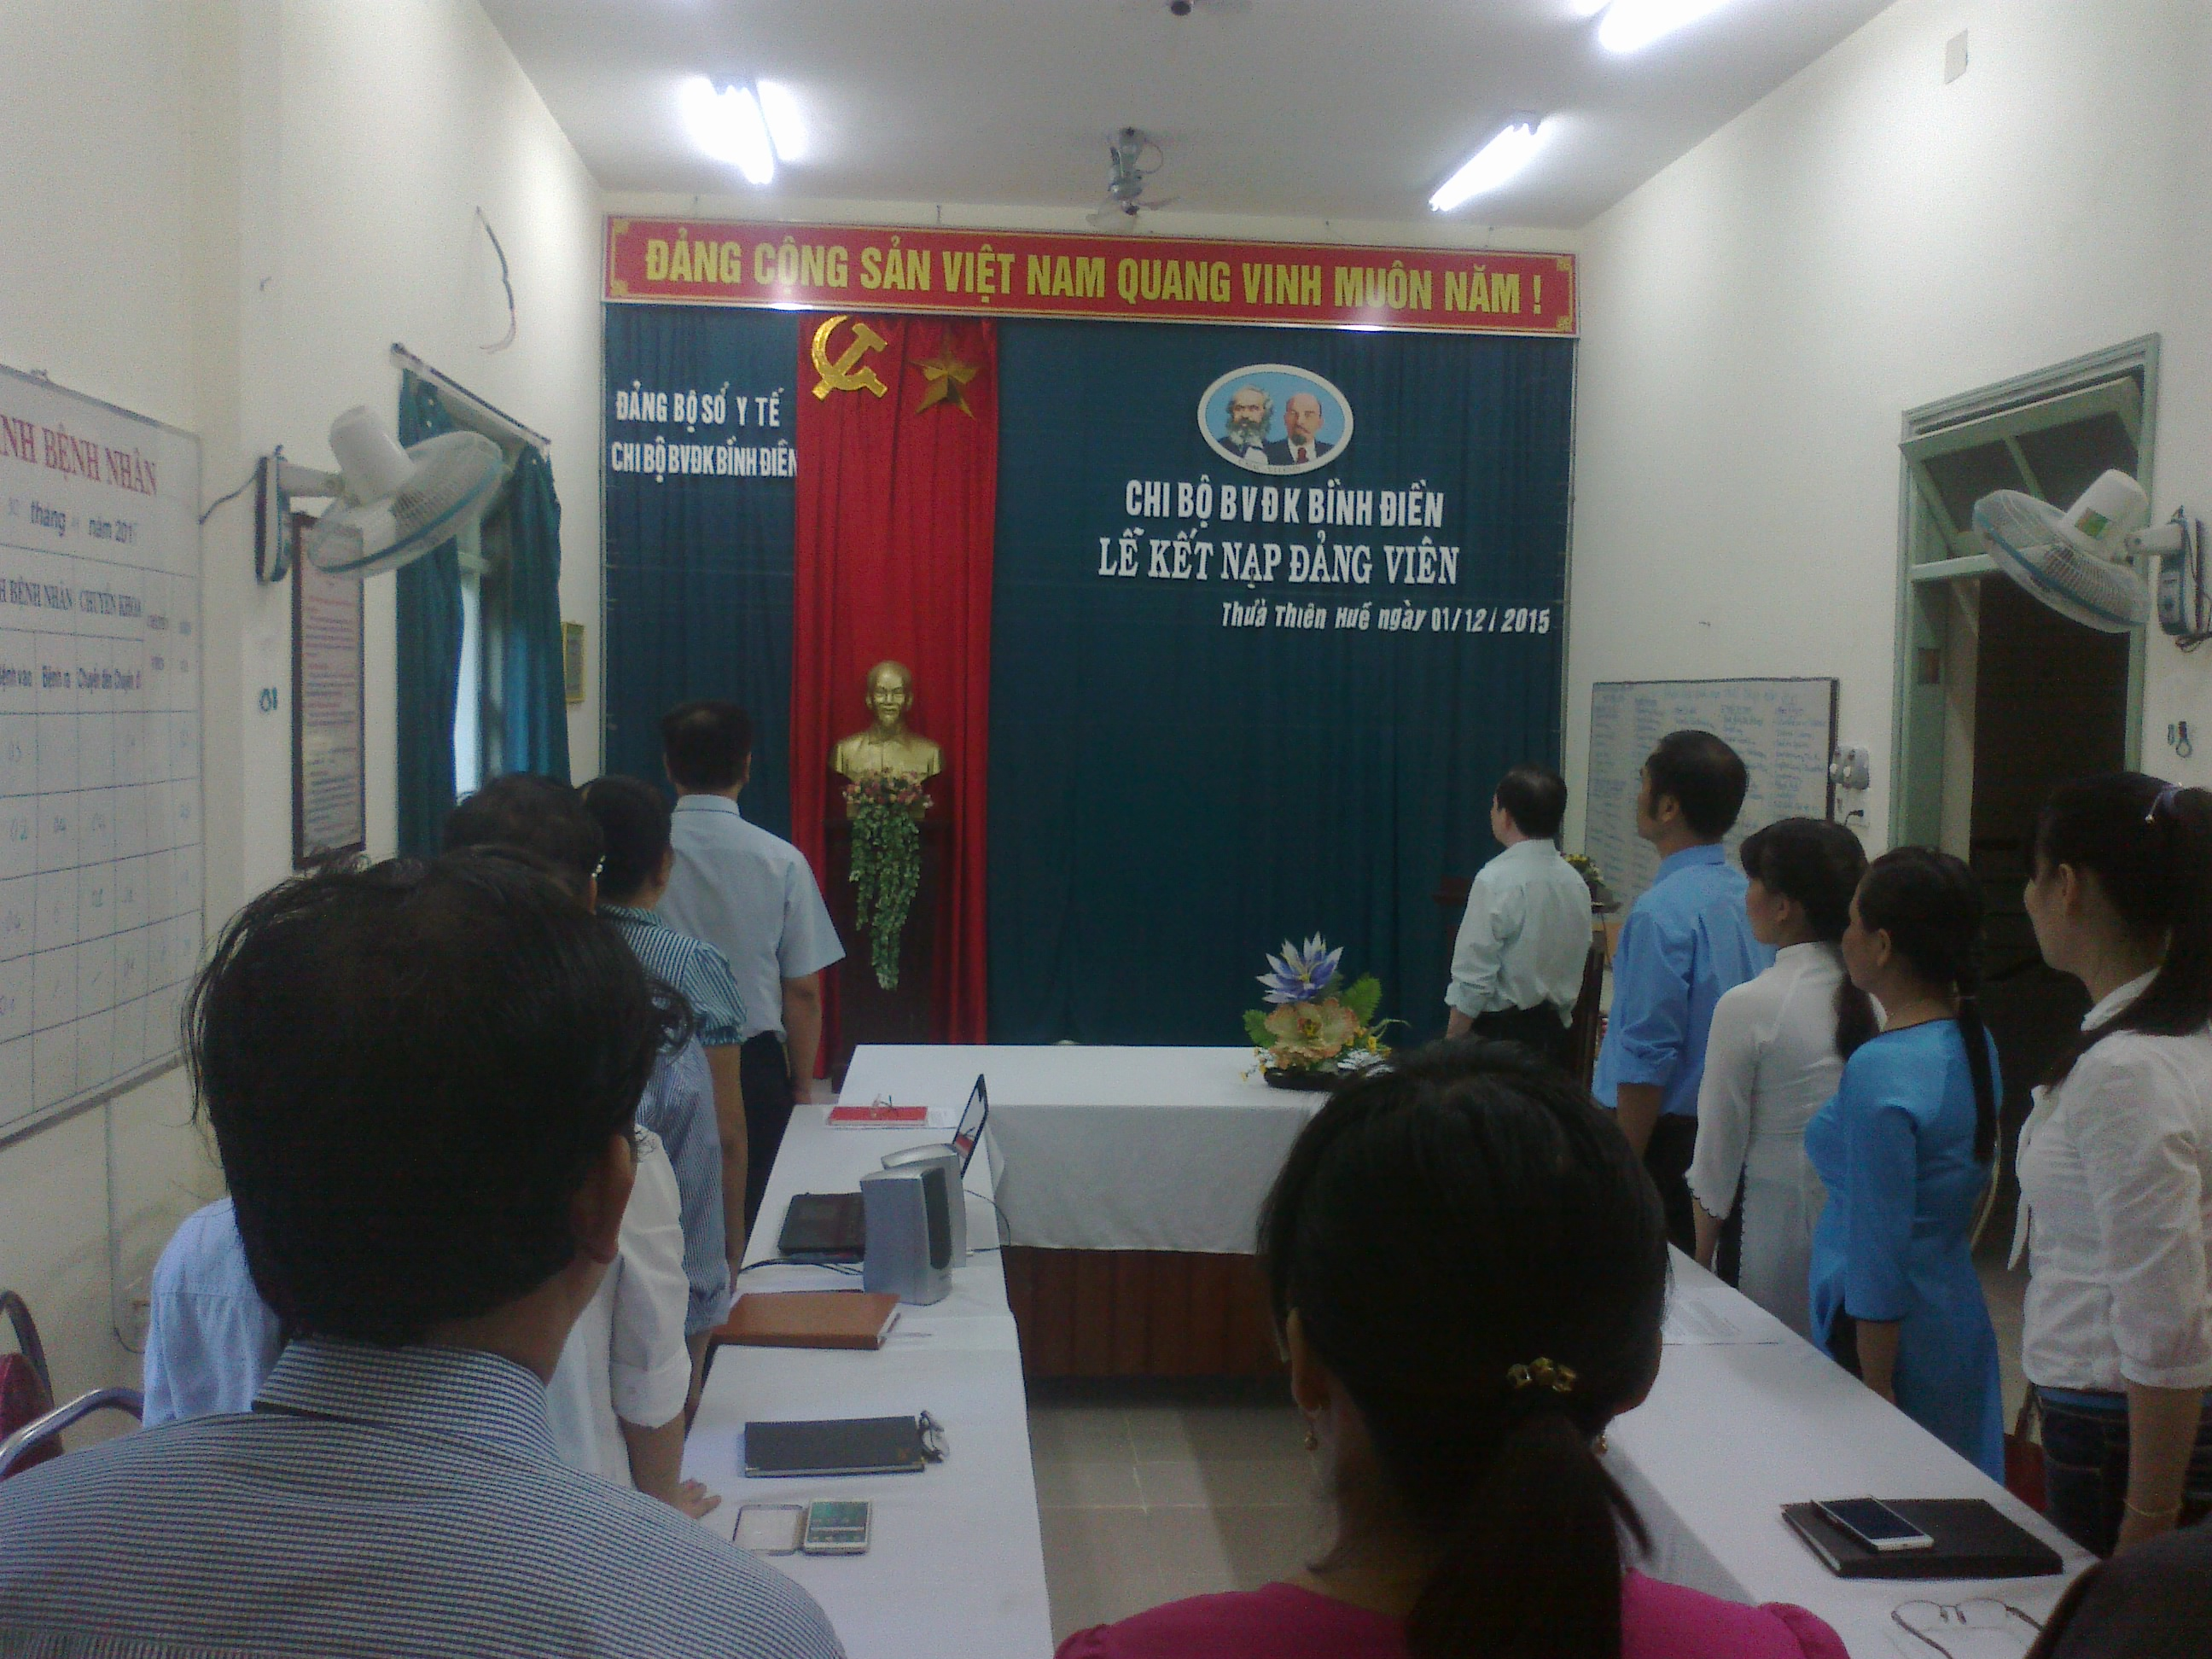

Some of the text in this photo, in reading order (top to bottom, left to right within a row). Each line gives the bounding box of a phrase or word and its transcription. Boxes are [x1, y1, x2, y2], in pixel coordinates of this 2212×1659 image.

[644, 228, 1542, 315] ĐẢNG CỘNG SẢN VIỆT NAM QUANG VINH MUÔN NĂM !
[616, 381, 668, 422] ĐẢNG
[673, 389, 698, 434] BỘ
[736, 396, 748, 427] Y
[754, 387, 784, 427] TẾ
[611, 440, 640, 473] CHI
[643, 435, 666, 483] BỘ
[668, 444, 715, 475] BVĐK
[1125, 474, 1444, 528] CHI BỘ BVĐK BÌNH ĐIỀN
[1098, 527, 1460, 589] LỄ KẾT NẠP ĐẢNG VIÊN
[1275, 602, 1327, 630] Thiên
[1335, 601, 1372, 631] Huế
[1377, 599, 1427, 632] ngày
